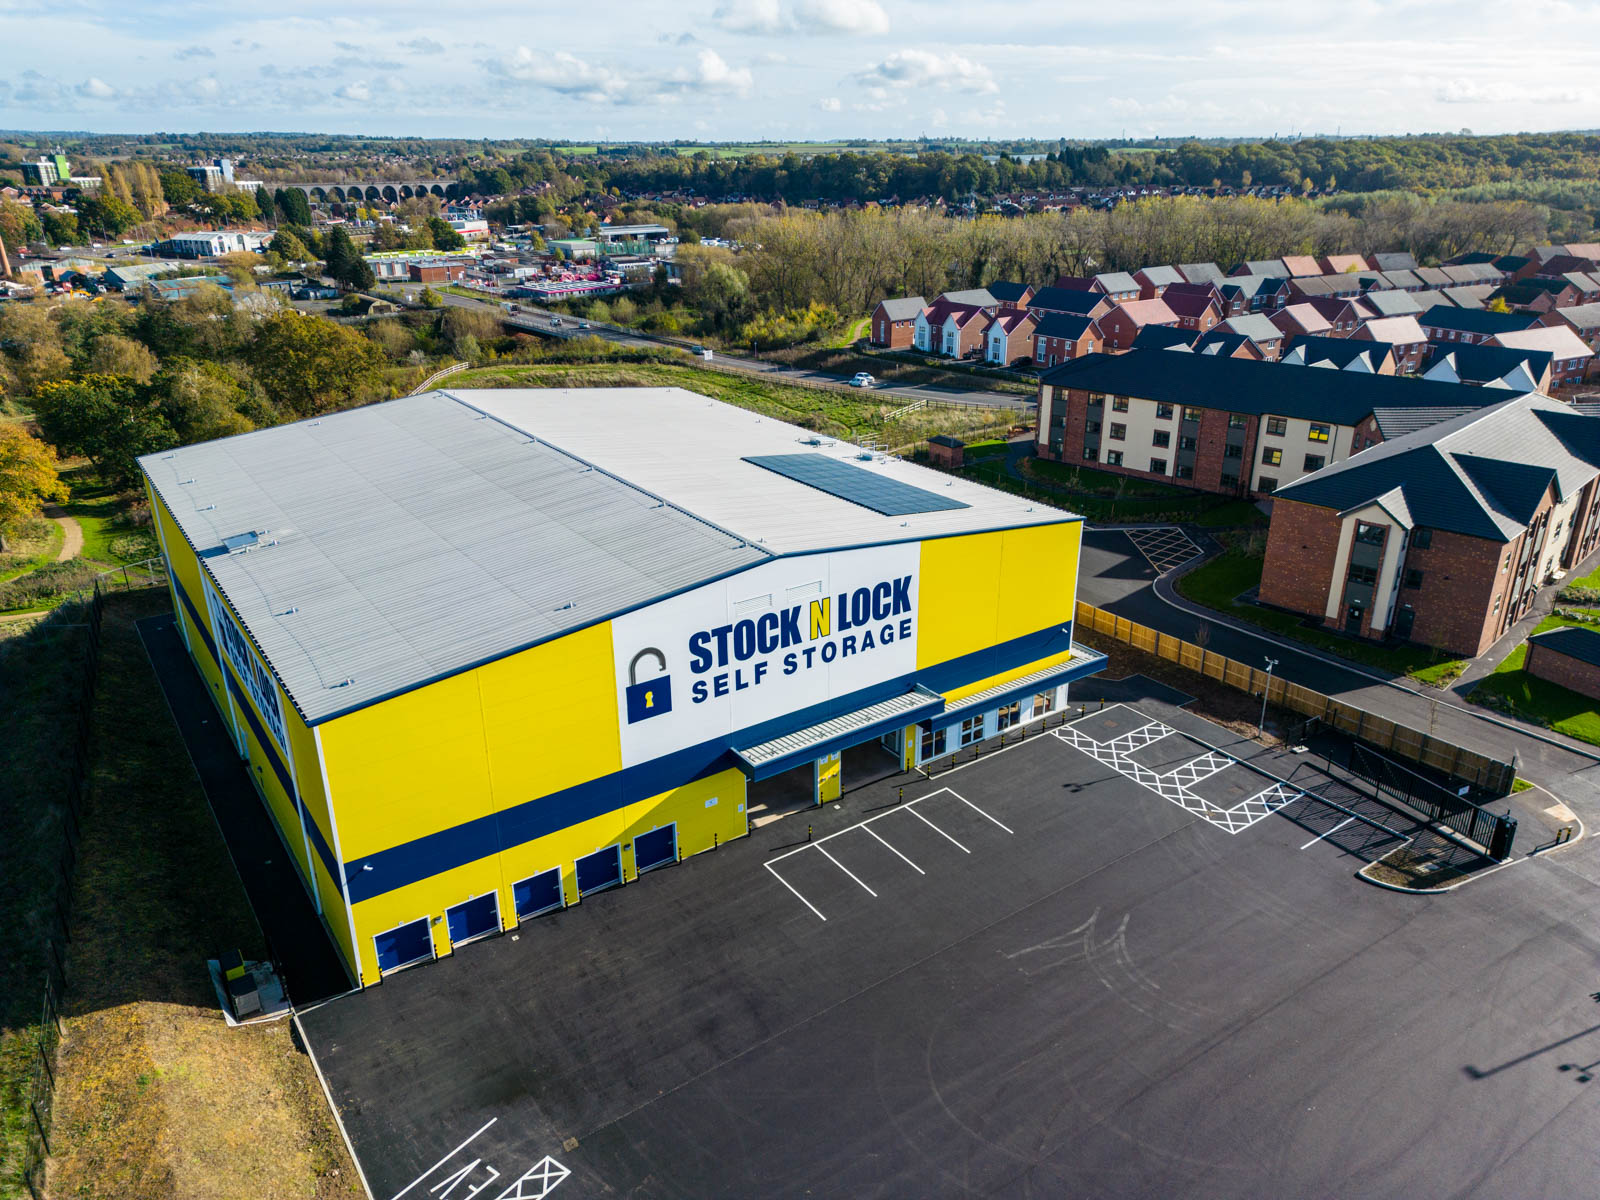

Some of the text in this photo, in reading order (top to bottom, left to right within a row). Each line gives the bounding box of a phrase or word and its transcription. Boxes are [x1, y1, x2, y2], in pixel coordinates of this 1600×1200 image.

[688, 574, 912, 675] STOCK N LOCK
[691, 617, 912, 704] SELF STORAGE
